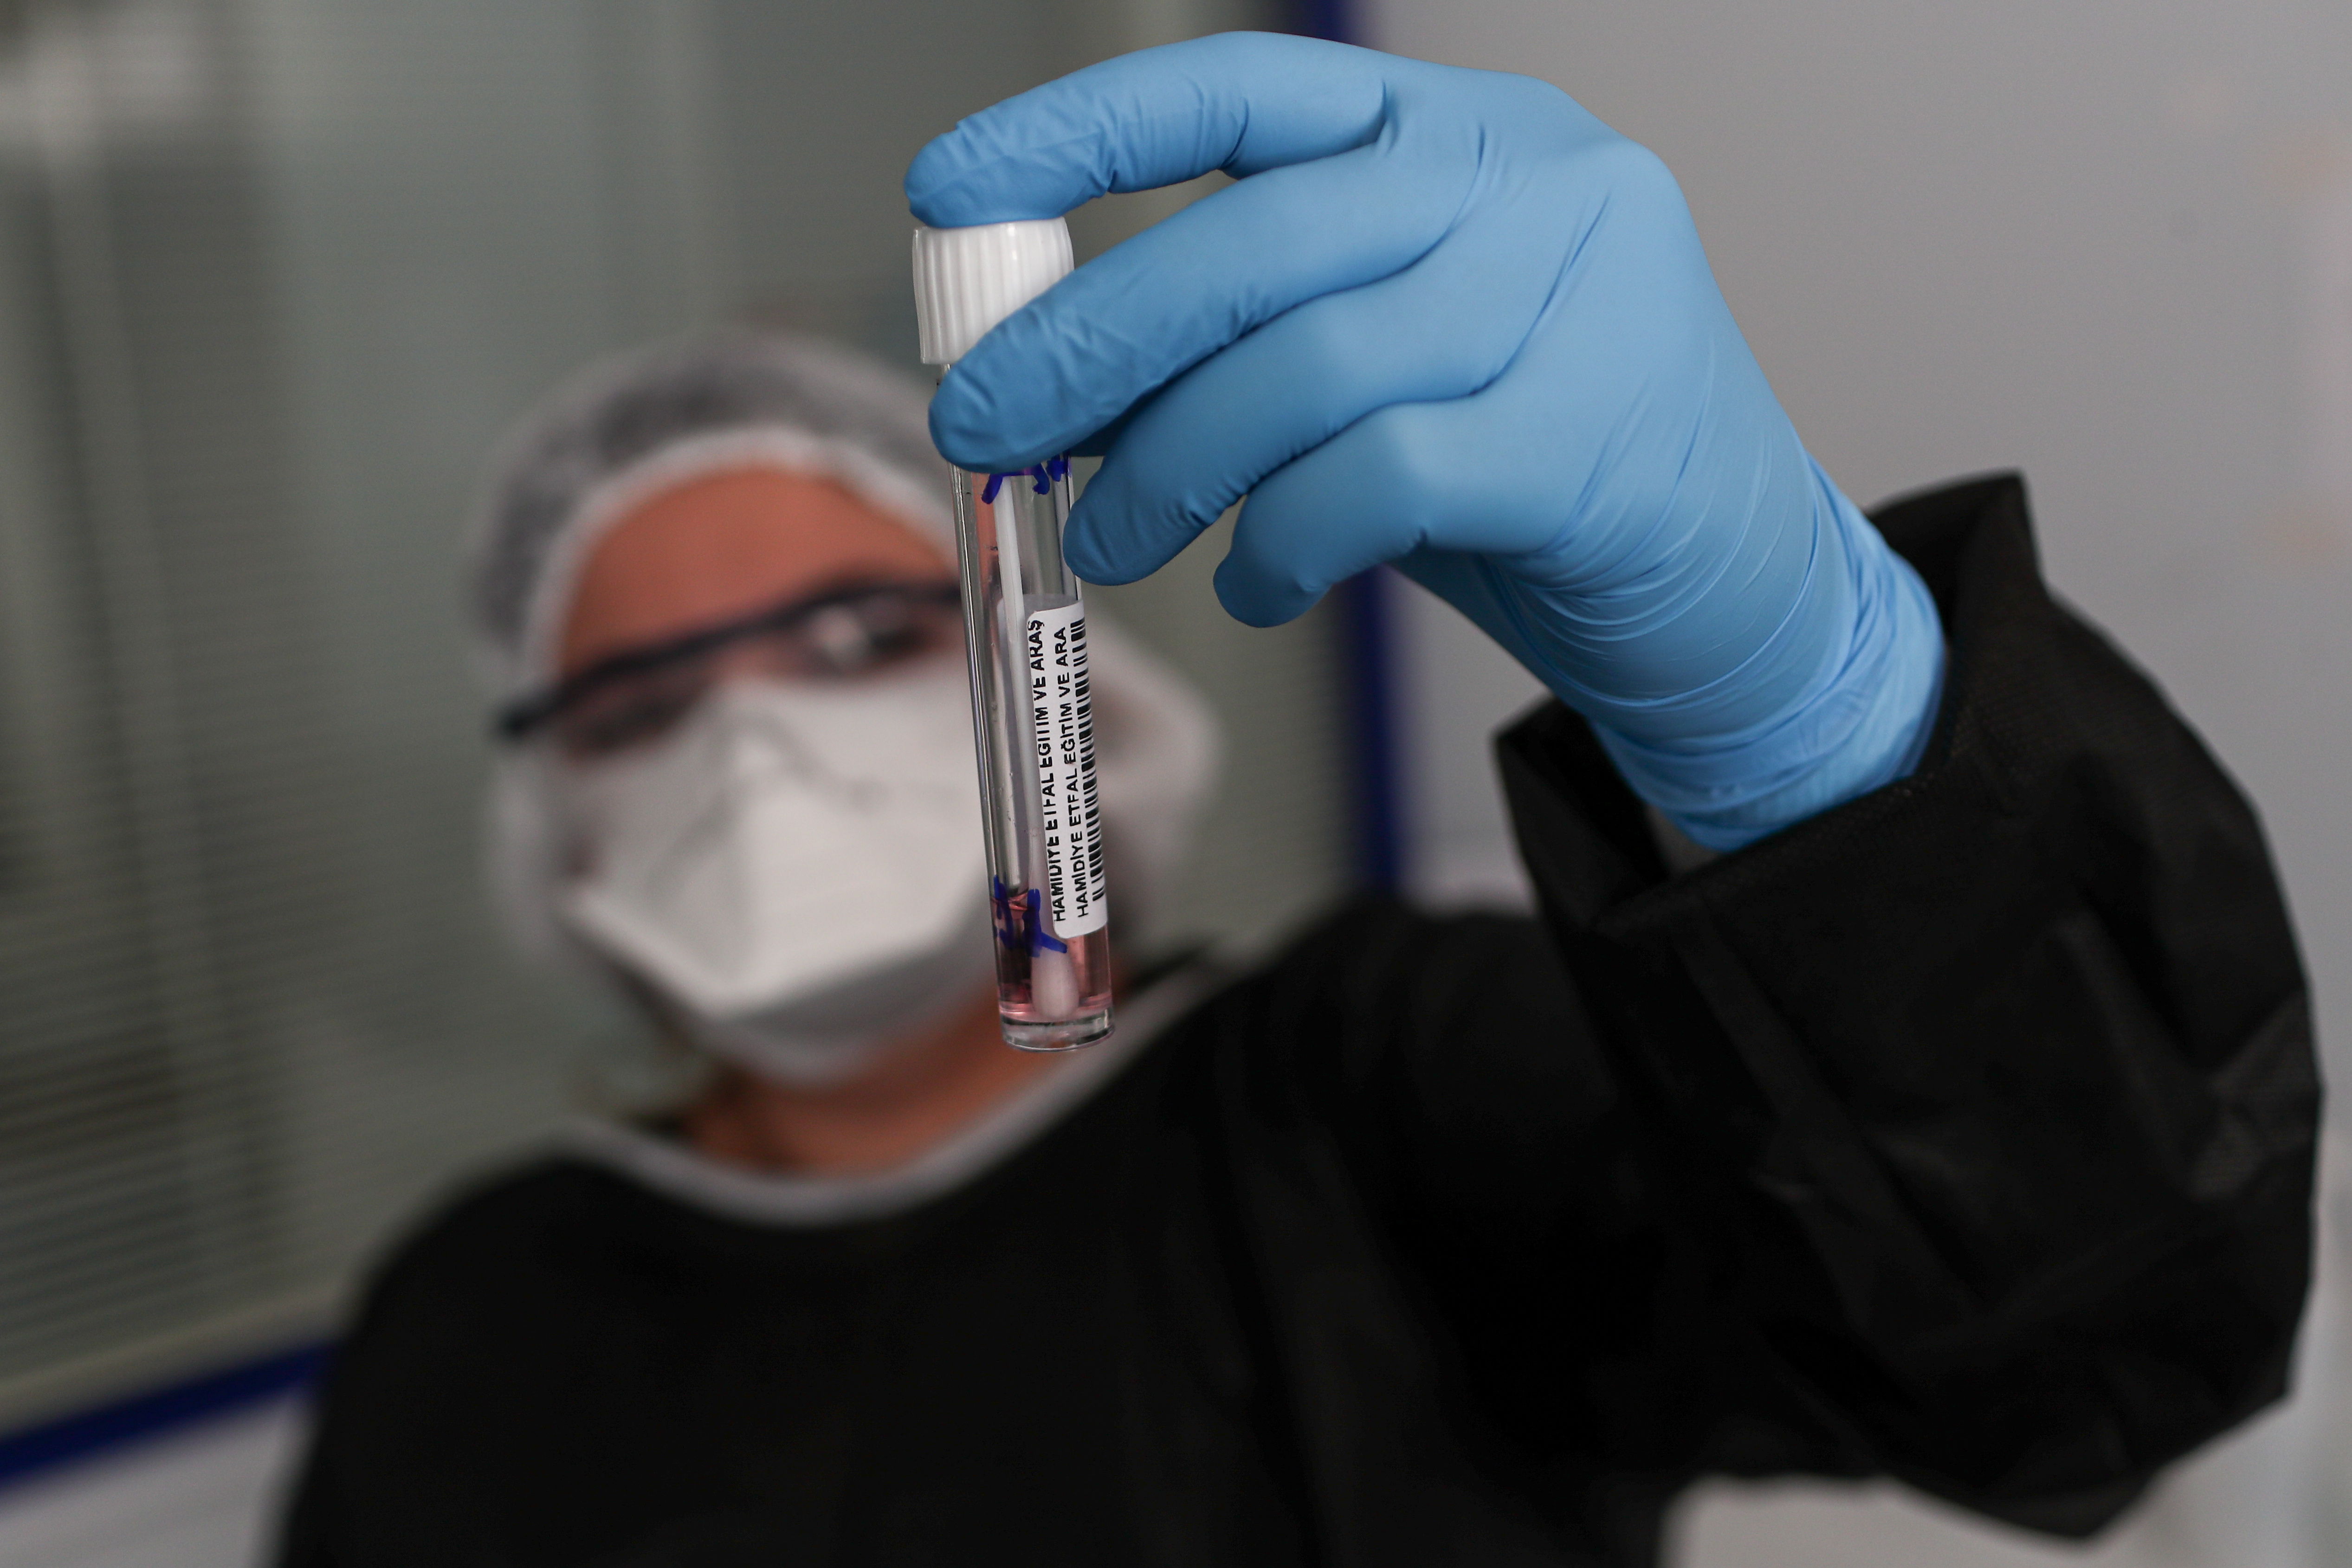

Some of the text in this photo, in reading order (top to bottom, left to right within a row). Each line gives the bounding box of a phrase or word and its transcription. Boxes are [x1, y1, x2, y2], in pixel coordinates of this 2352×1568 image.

[1054, 627, 1068, 666] ARA
[1033, 677, 1047, 701] VE
[1058, 672, 1070, 697] VE
[1066, 768, 1081, 826] ETFAL
